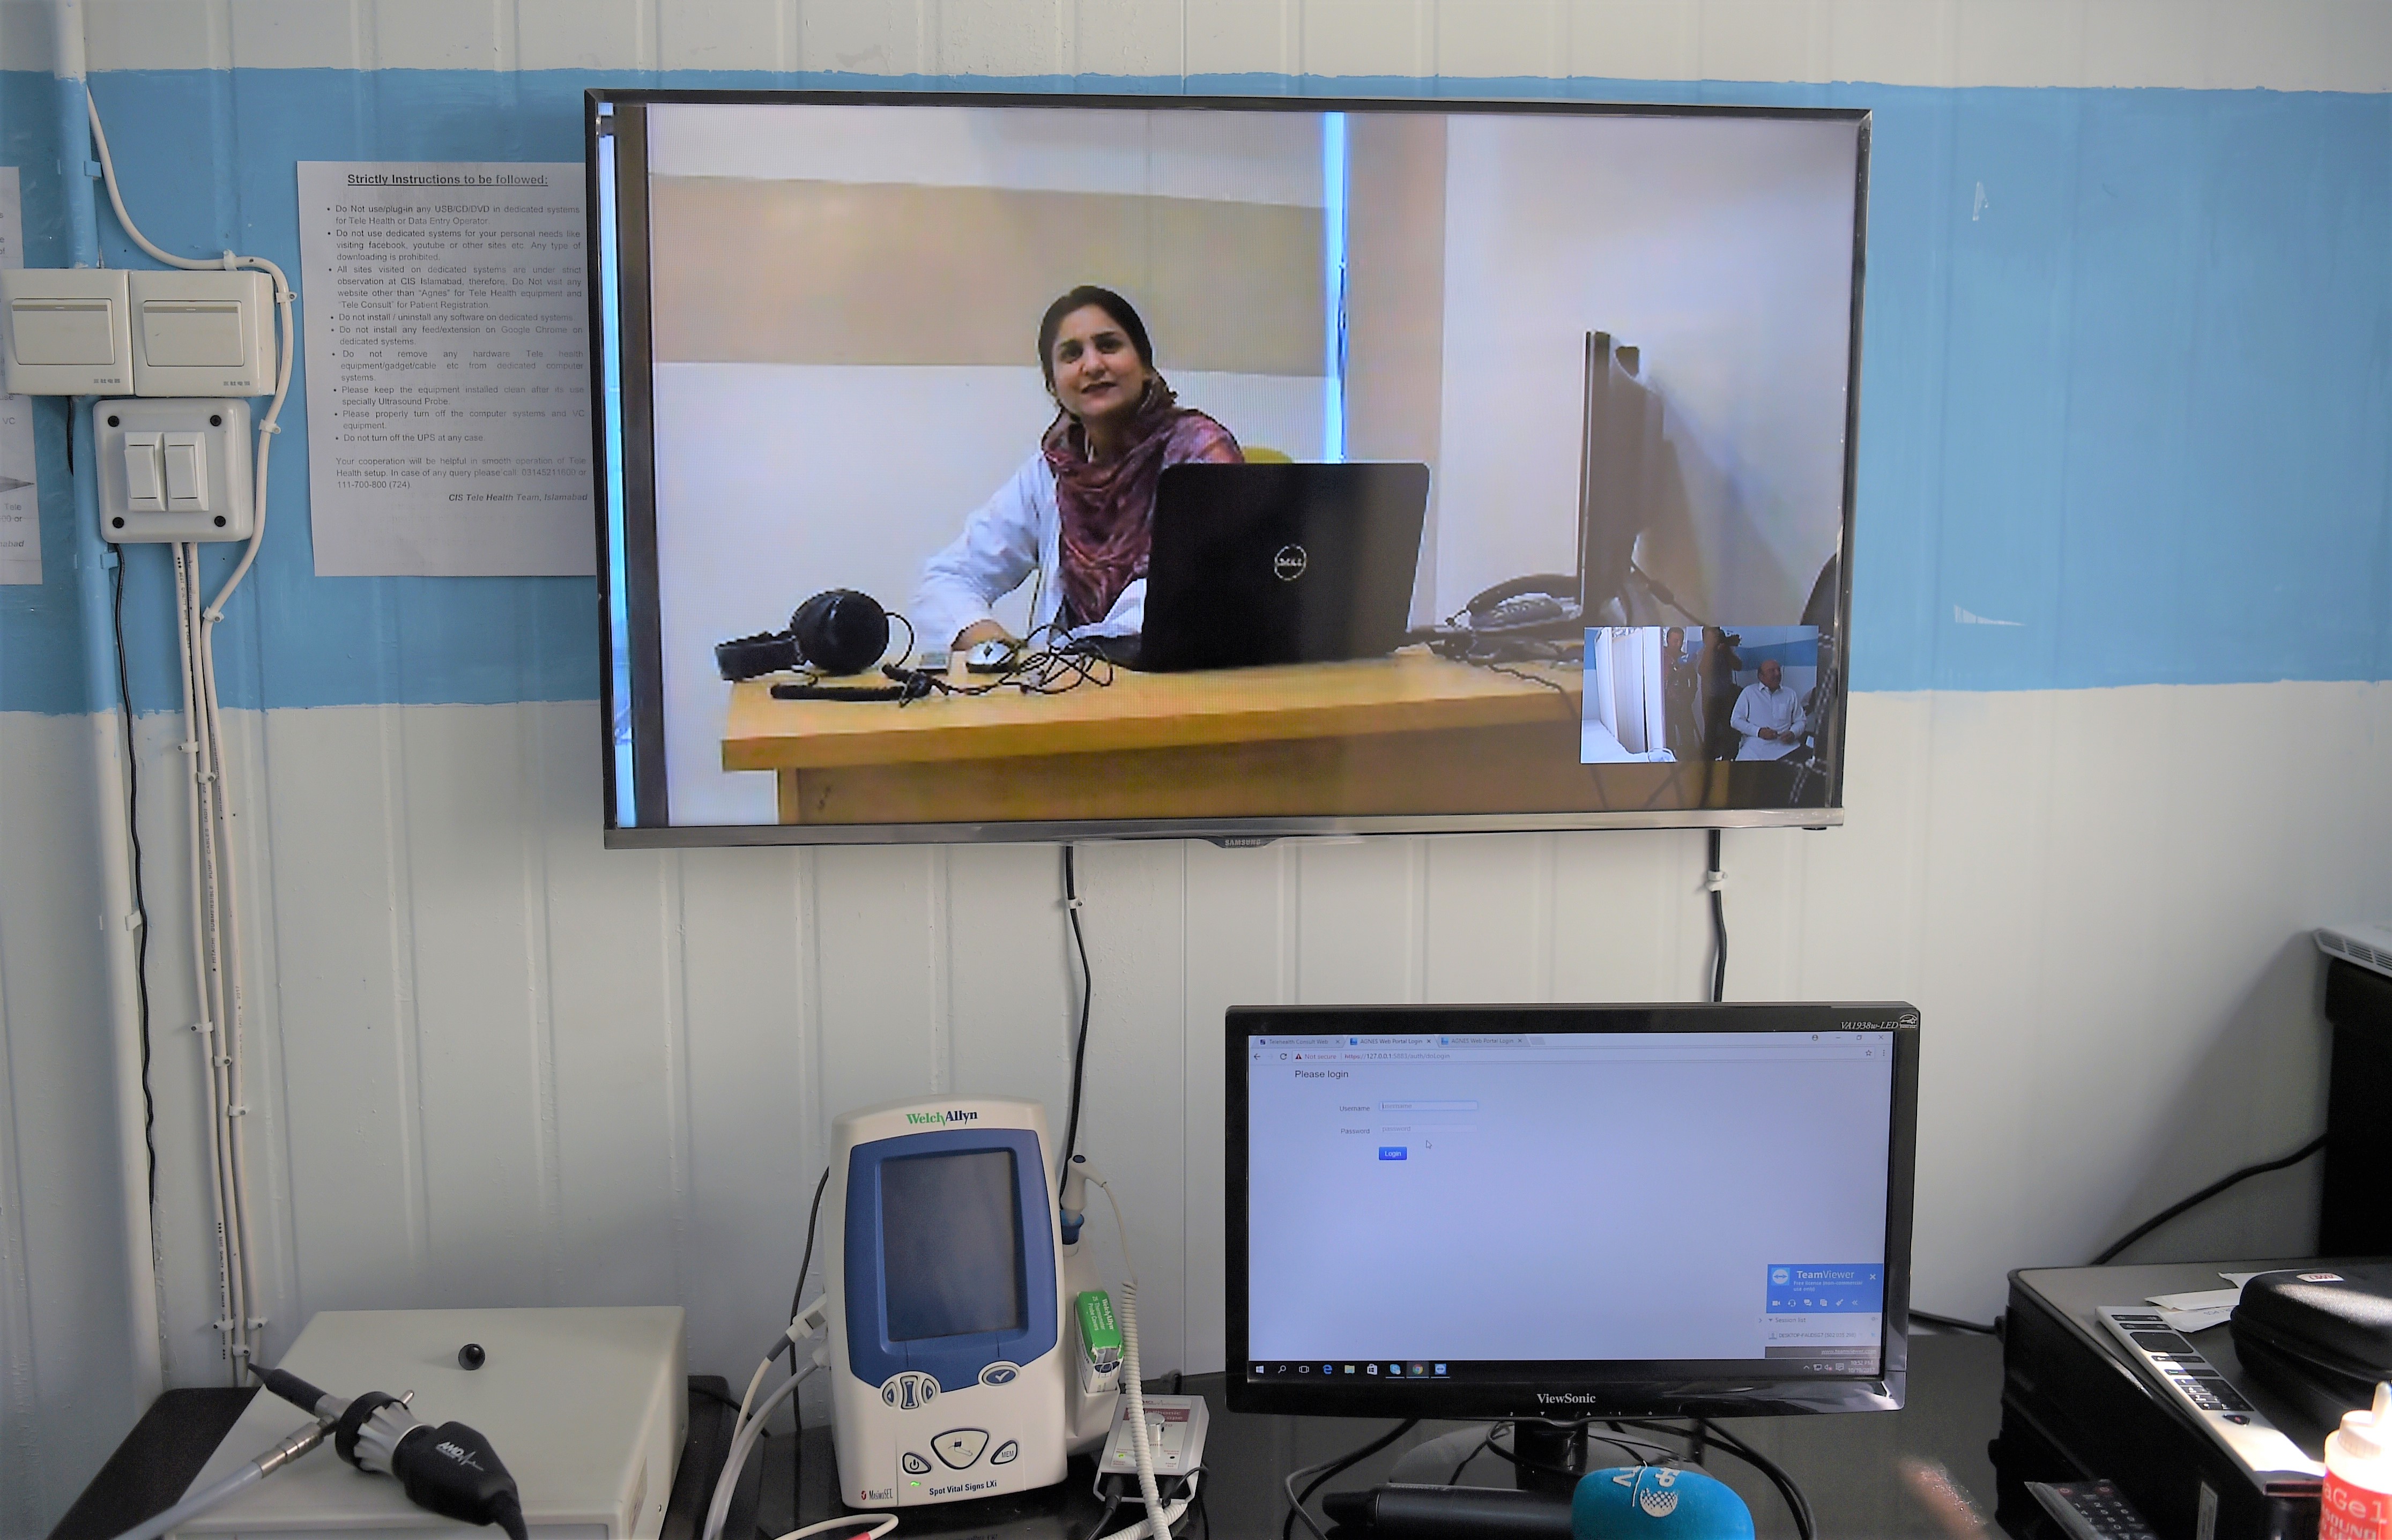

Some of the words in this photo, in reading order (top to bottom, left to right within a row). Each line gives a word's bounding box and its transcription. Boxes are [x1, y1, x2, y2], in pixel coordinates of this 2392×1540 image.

[347, 174, 389, 185] Strictly
[392, 174, 460, 184] Instructions
[464, 175, 476, 184] to
[478, 174, 492, 184] be
[495, 174, 548, 185] followed:
[335, 204, 347, 213] Do
[351, 205, 365, 213] Not
[368, 205, 413, 215] use/plug-in
[416, 206, 431, 214] any
[434, 205, 490, 213] USB/CD/DVD
[503, 205, 544, 213] dedicated
[546, 206, 581, 215] systems
[336, 217, 347, 225] for
[348, 217, 366, 225] Tele
[369, 217, 396, 225] Health
[408, 217, 427, 225] Data
[429, 217, 450, 226] Entry
[452, 217, 489, 226] Operator.
[336, 229, 348, 237] Do
[385, 229, 425, 237] dedicated
[428, 230, 462, 239] systems
[465, 229, 476, 237] for
[479, 231, 497, 239] your
[500, 229, 536, 239] personal
[566, 230, 581, 238] like
[337, 253, 387, 263] downloading
[398, 253, 440, 262] prohibited.
[400, 277, 416, 285] CIS
[420, 277, 464, 286] Islamabad,
[469, 277, 508, 286] therefore,
[512, 277, 524, 285] Do
[528, 278, 543, 286] Not
[567, 279, 582, 287] any
[372, 289, 393, 297] other
[397, 289, 415, 297] than
[454, 289, 465, 297] for
[469, 289, 487, 297] Tele
[490, 289, 517, 297] Health
[520, 290, 563, 299] equipment
[339, 313, 351, 321] Do
[367, 313, 391, 321] install
[398, 313, 431, 321] uninstall
[433, 315, 448, 323] any
[450, 313, 485, 321] software
[498, 313, 538, 321] dedicated
[340, 361, 437, 371] equipment/gadget/cable
[446, 362, 459, 370] etc
[469, 361, 487, 369] from
[496, 362, 536, 370] dedicated
[546, 362, 584, 370] computer
[342, 398, 376, 407] specially
[378, 397, 422, 405] Ultrasound
[424, 397, 450, 405] Probe.
[343, 422, 387, 431] equipment.
[344, 434, 355, 442] Do
[389, 433, 400, 442] off
[402, 434, 415, 442] the
[417, 433, 436, 442] UPS
[437, 434, 446, 442] at
[447, 435, 462, 443] any
[337, 480, 387, 489] 111-700-800
[389, 480, 412, 490] (724).
[448, 493, 464, 502] CIS
[466, 493, 484, 502] Tele
[486, 493, 514, 502] Health
[516, 493, 542, 502] Team,
[544, 493, 589, 501] Islamabad
[1841, 1021, 1899, 1030] VA1938w-LED
[1295, 1070, 1325, 1078] Please
[1327, 1070, 1349, 1080] login
[1796, 1270, 1855, 1279] TeamViewer
[1091, 1315, 1099, 1331] Covers
[1536, 1393, 1596, 1404] ViewSonic
[1001, 1450, 1014, 1459] MEM
[929, 1487, 946, 1497] Spot
[947, 1484, 963, 1494] Vital
[965, 1483, 984, 1492] Signs
[986, 1479, 997, 1488] LXi
